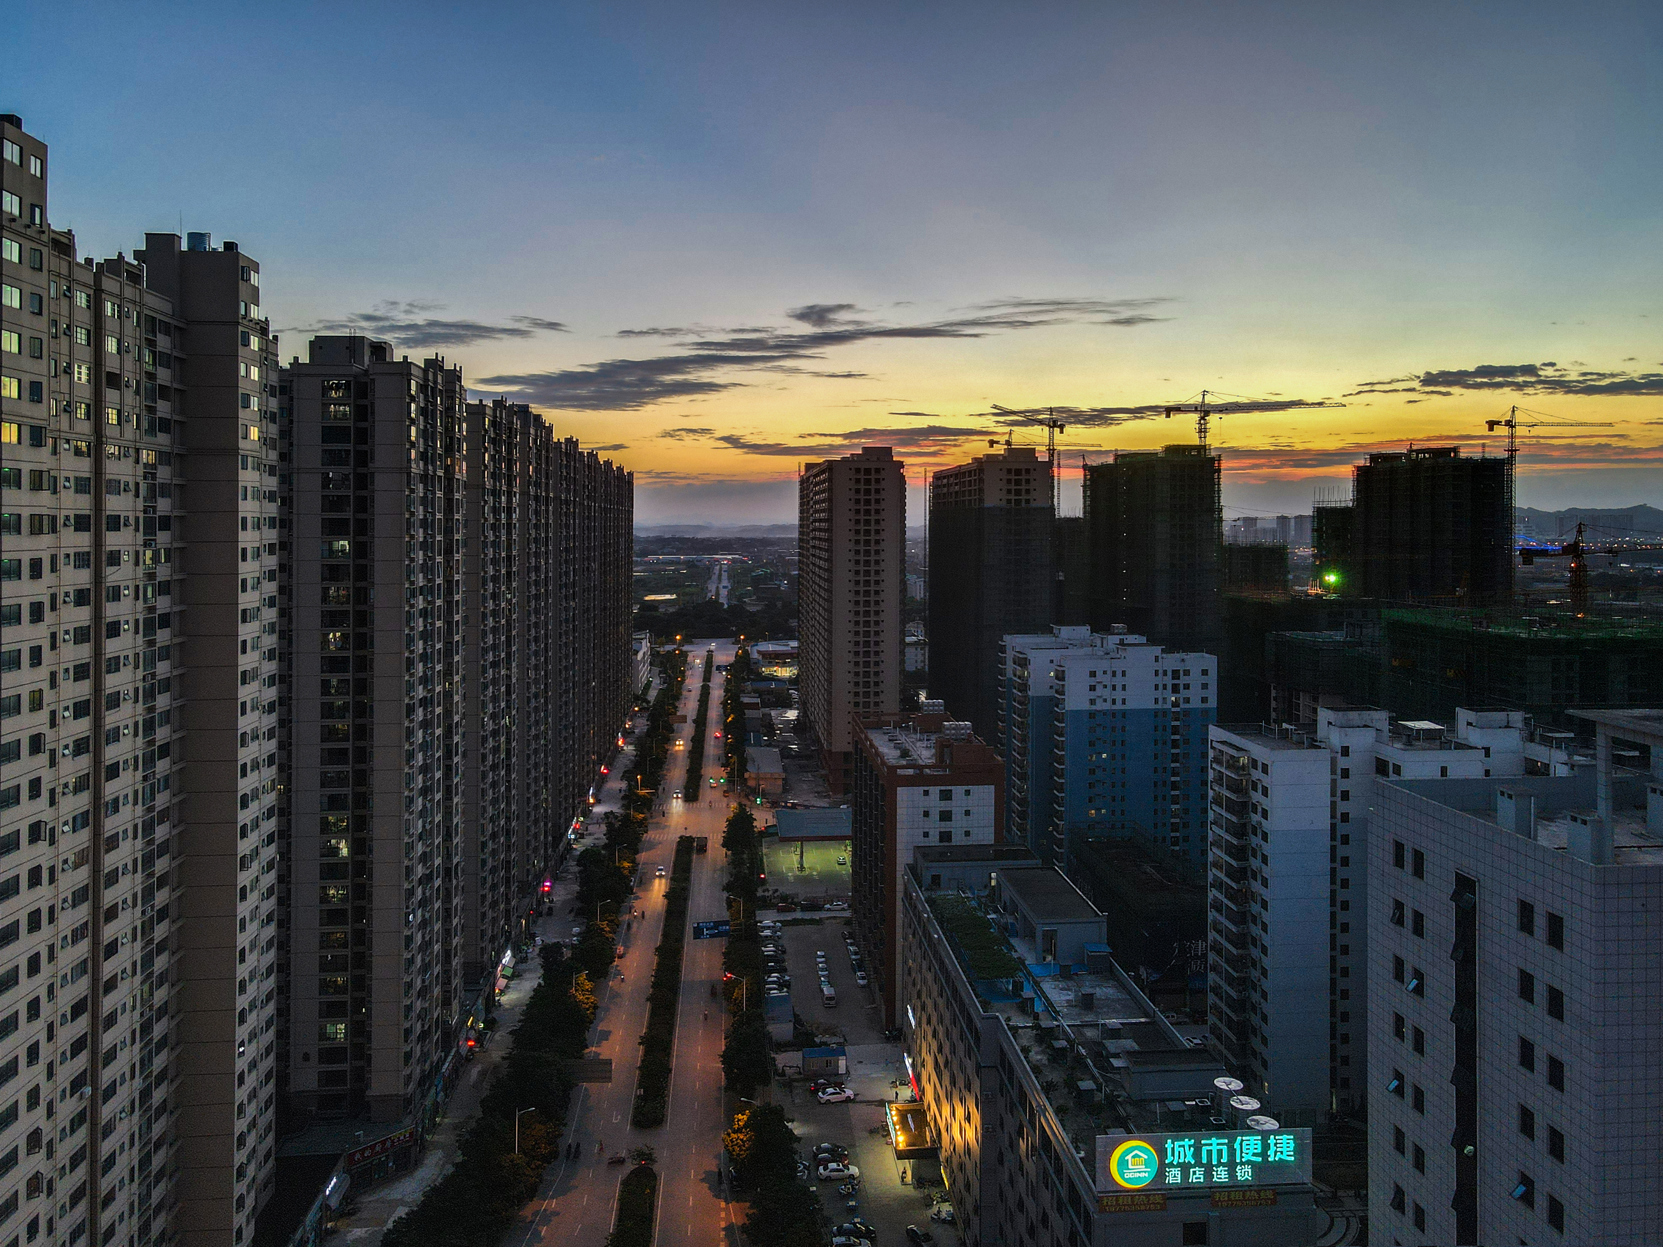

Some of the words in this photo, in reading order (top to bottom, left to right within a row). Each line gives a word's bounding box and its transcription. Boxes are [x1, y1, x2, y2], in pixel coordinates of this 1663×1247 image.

[1164, 1134, 1295, 1165] 城市便捷
[1164, 1164, 1252, 1184] 酒店连锁
[1102, 1194, 1164, 1206] 招租热线
[1214, 1189, 1274, 1201] 招租热线
